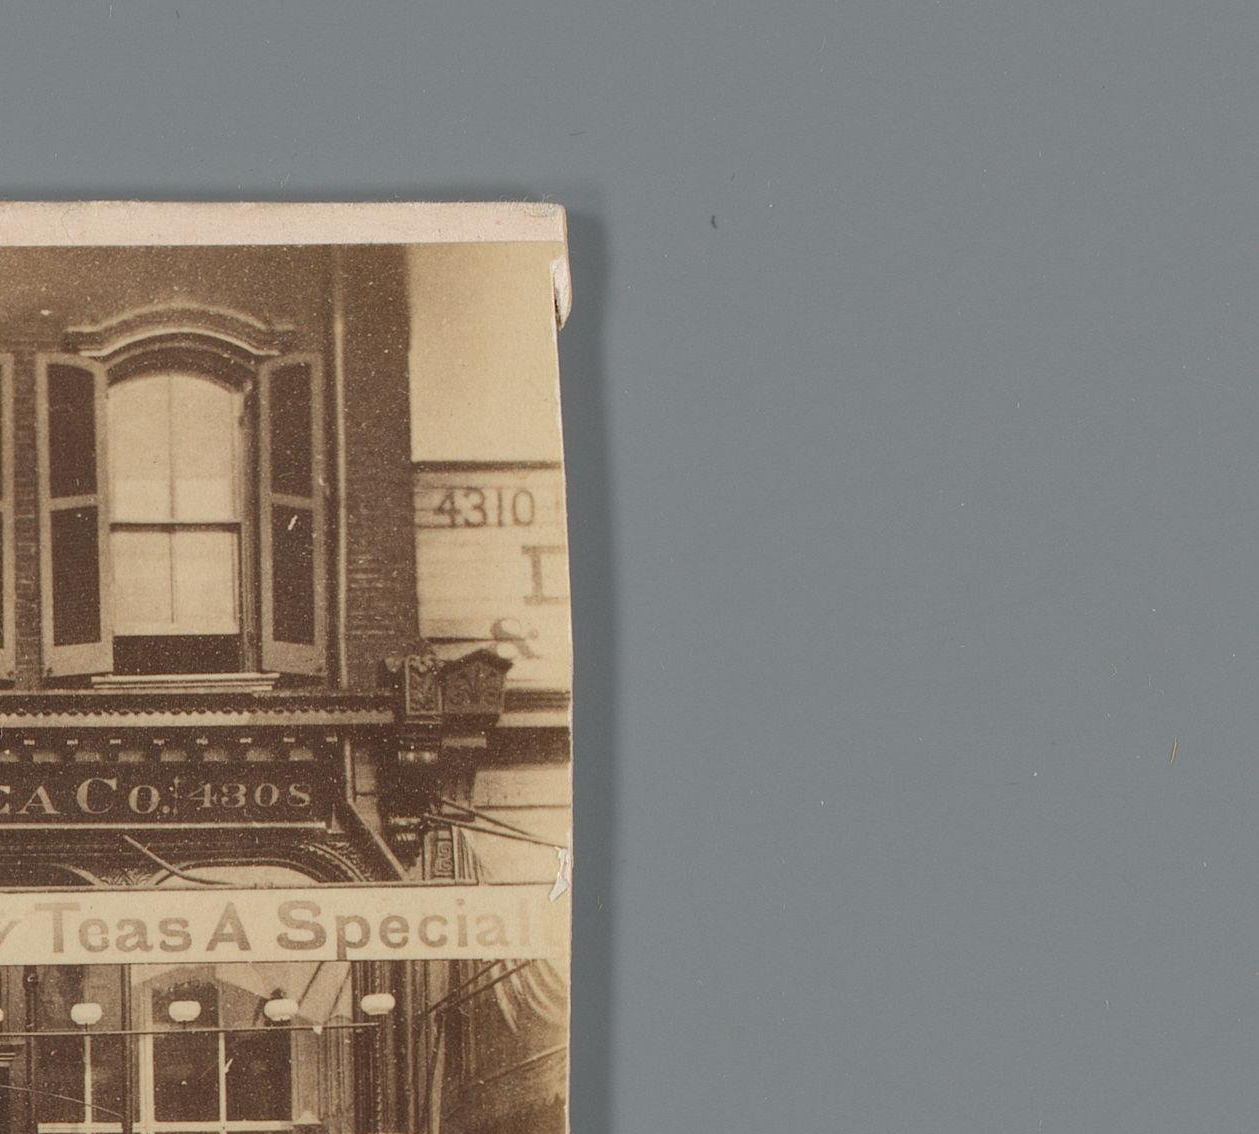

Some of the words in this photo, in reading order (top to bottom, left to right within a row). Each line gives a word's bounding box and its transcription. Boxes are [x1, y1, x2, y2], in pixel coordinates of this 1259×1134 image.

[433, 486, 535, 528] 4310
[188, 782, 313, 809] 4308
[34, 901, 193, 955] Teas
[205, 900, 252, 952] A
[275, 899, 553, 960] Special
